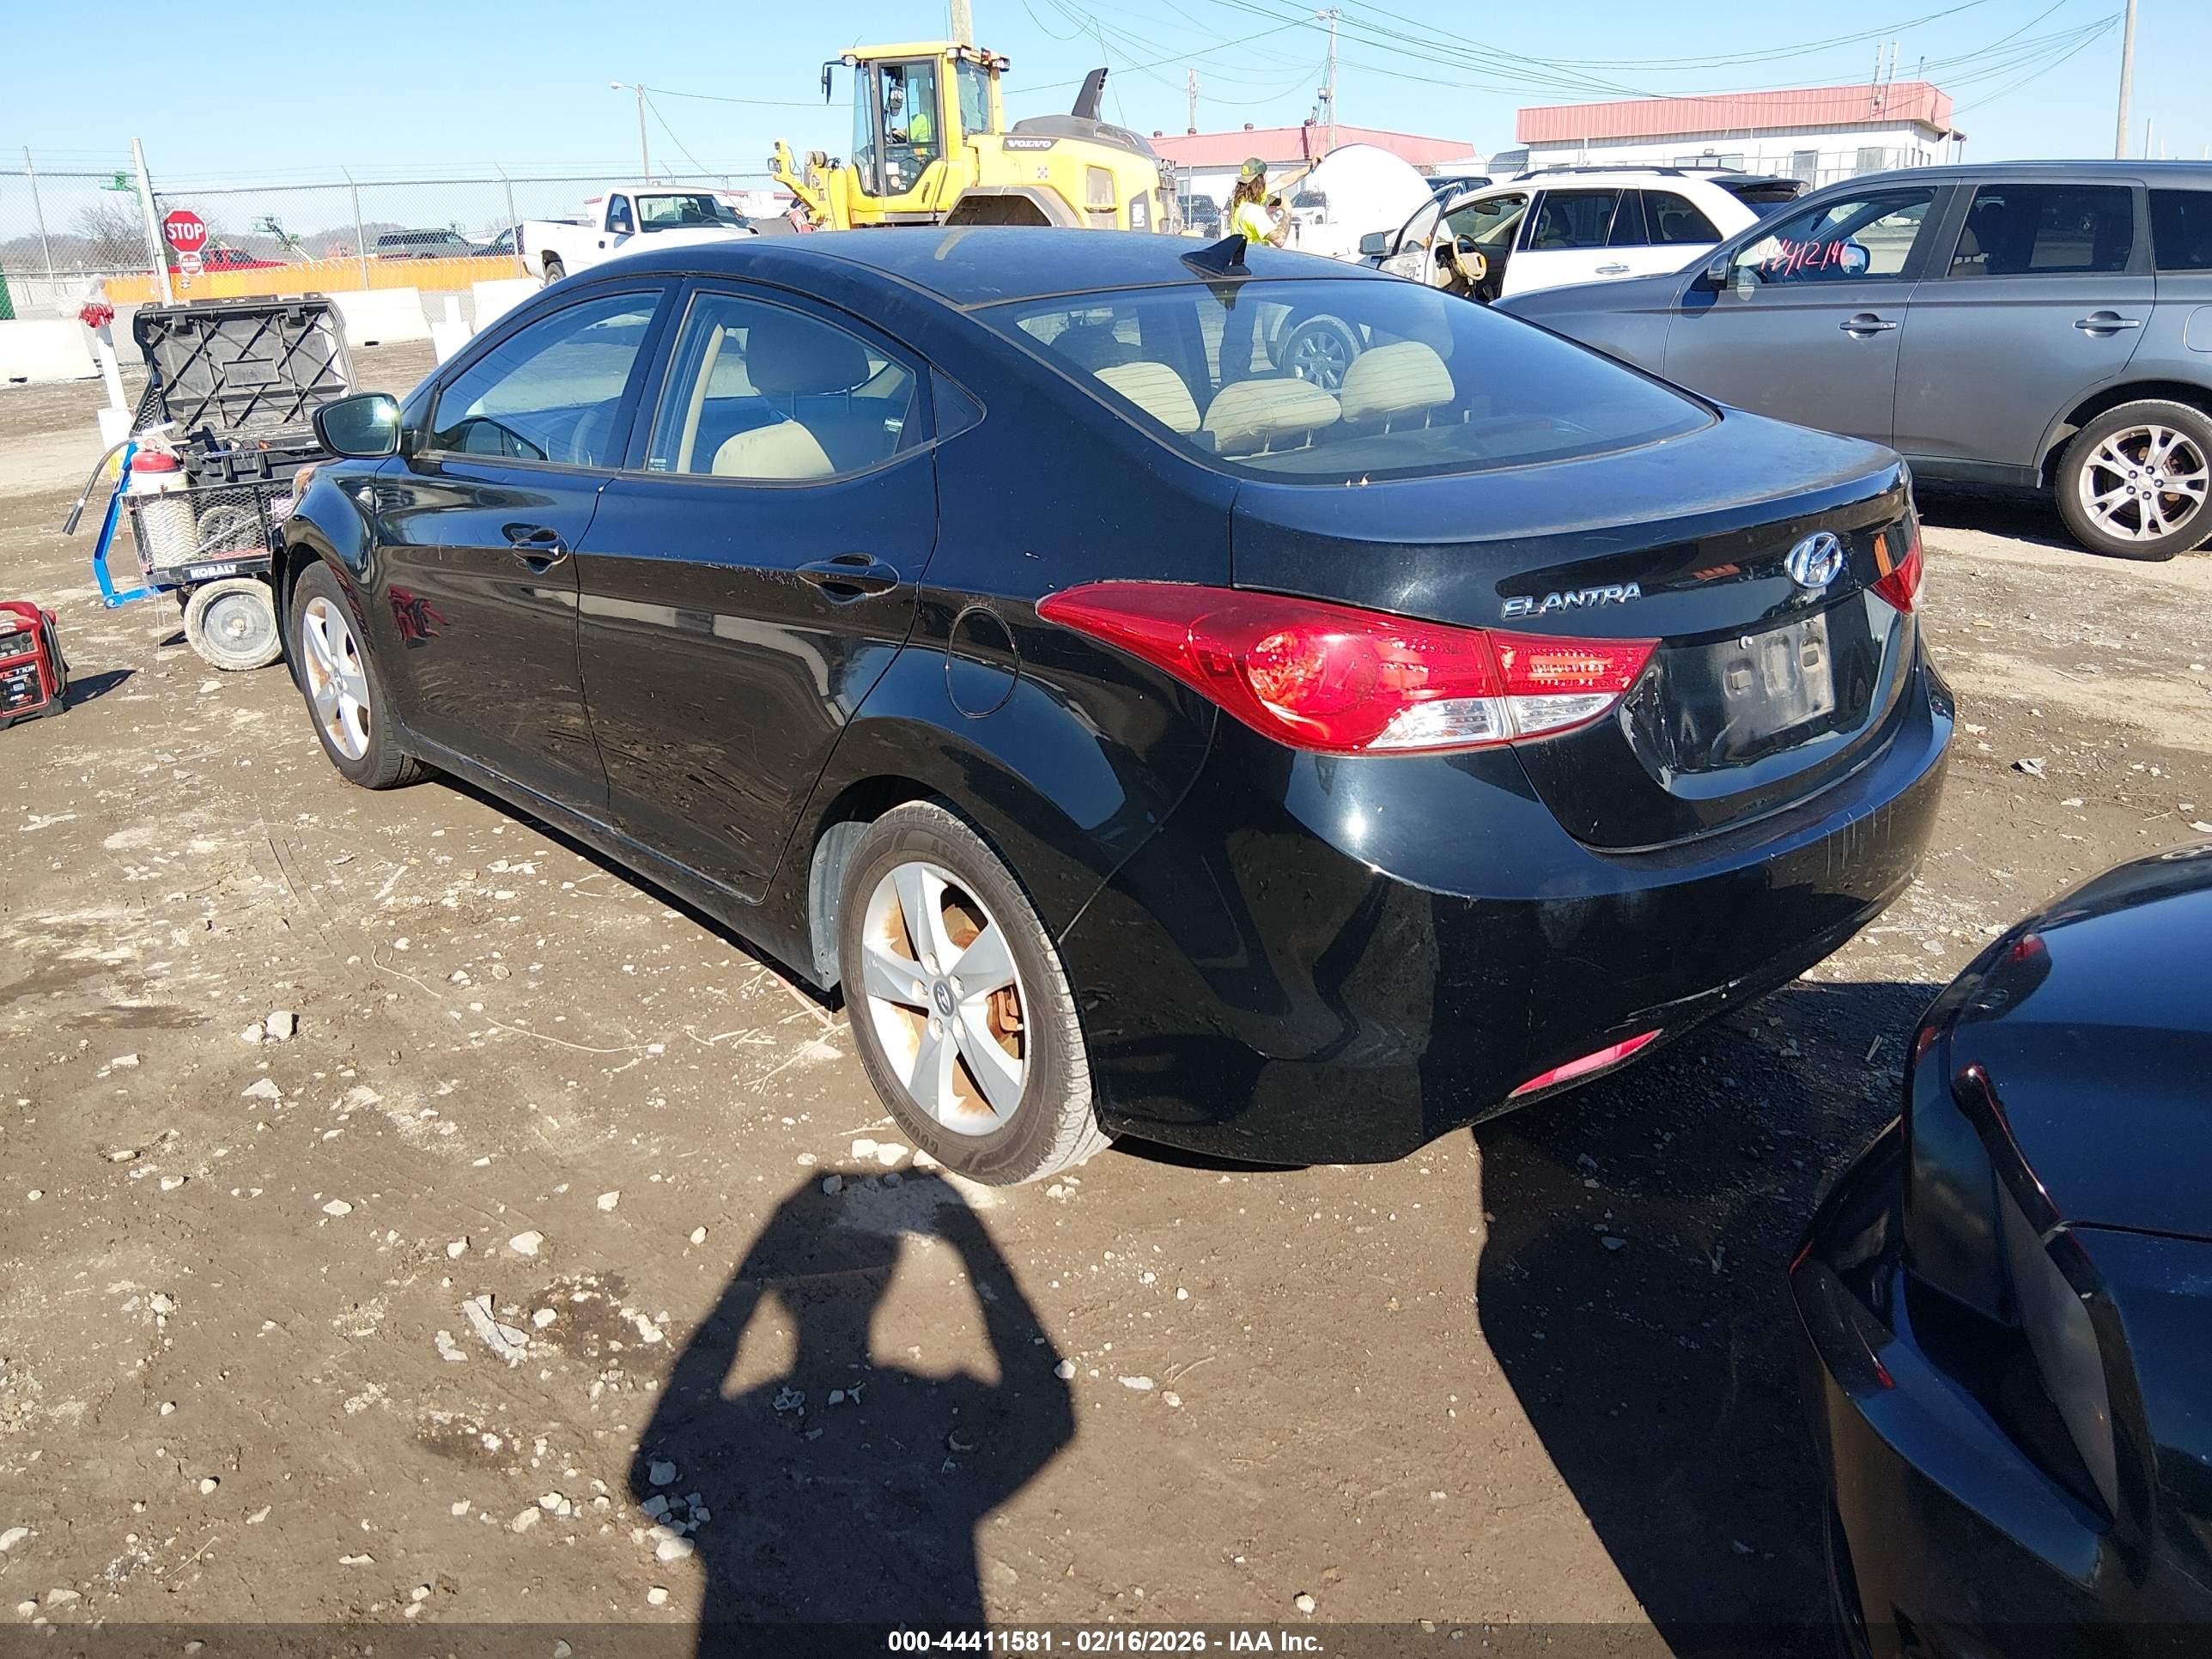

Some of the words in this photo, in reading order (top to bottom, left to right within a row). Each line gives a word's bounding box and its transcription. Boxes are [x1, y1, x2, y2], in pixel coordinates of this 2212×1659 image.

[166, 223, 204, 240] STOP
[1758, 239, 1856, 276] 44412146
[190, 564, 237, 579] KOBALT
[1501, 582, 1642, 620] ELANTRA
